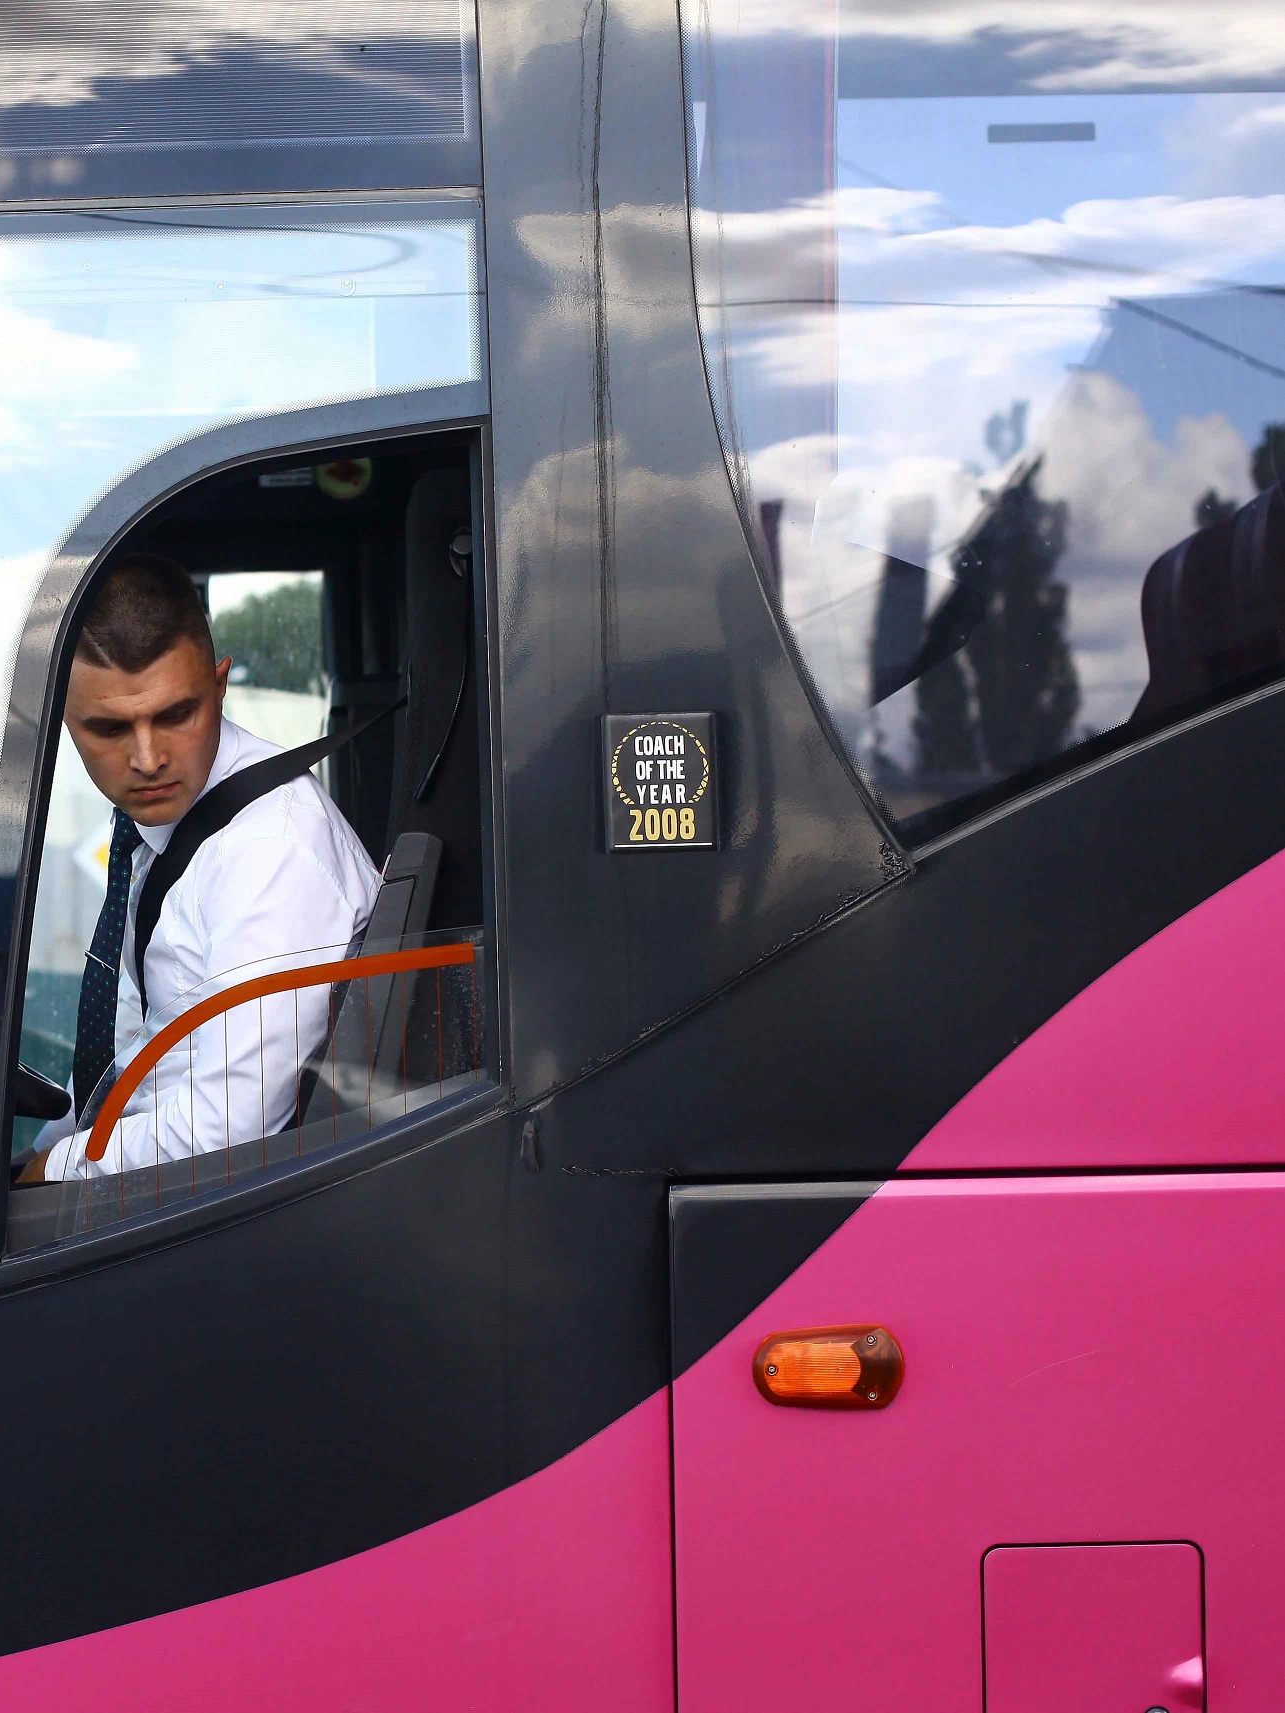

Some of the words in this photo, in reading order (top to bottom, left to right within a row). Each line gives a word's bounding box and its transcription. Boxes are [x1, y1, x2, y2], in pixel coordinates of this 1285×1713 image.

[634, 735, 685, 756] COACH
[635, 760, 654, 780] OF
[657, 759, 686, 780] THE
[636, 783, 686, 805] YEAR
[629, 808, 696, 841] 2008
